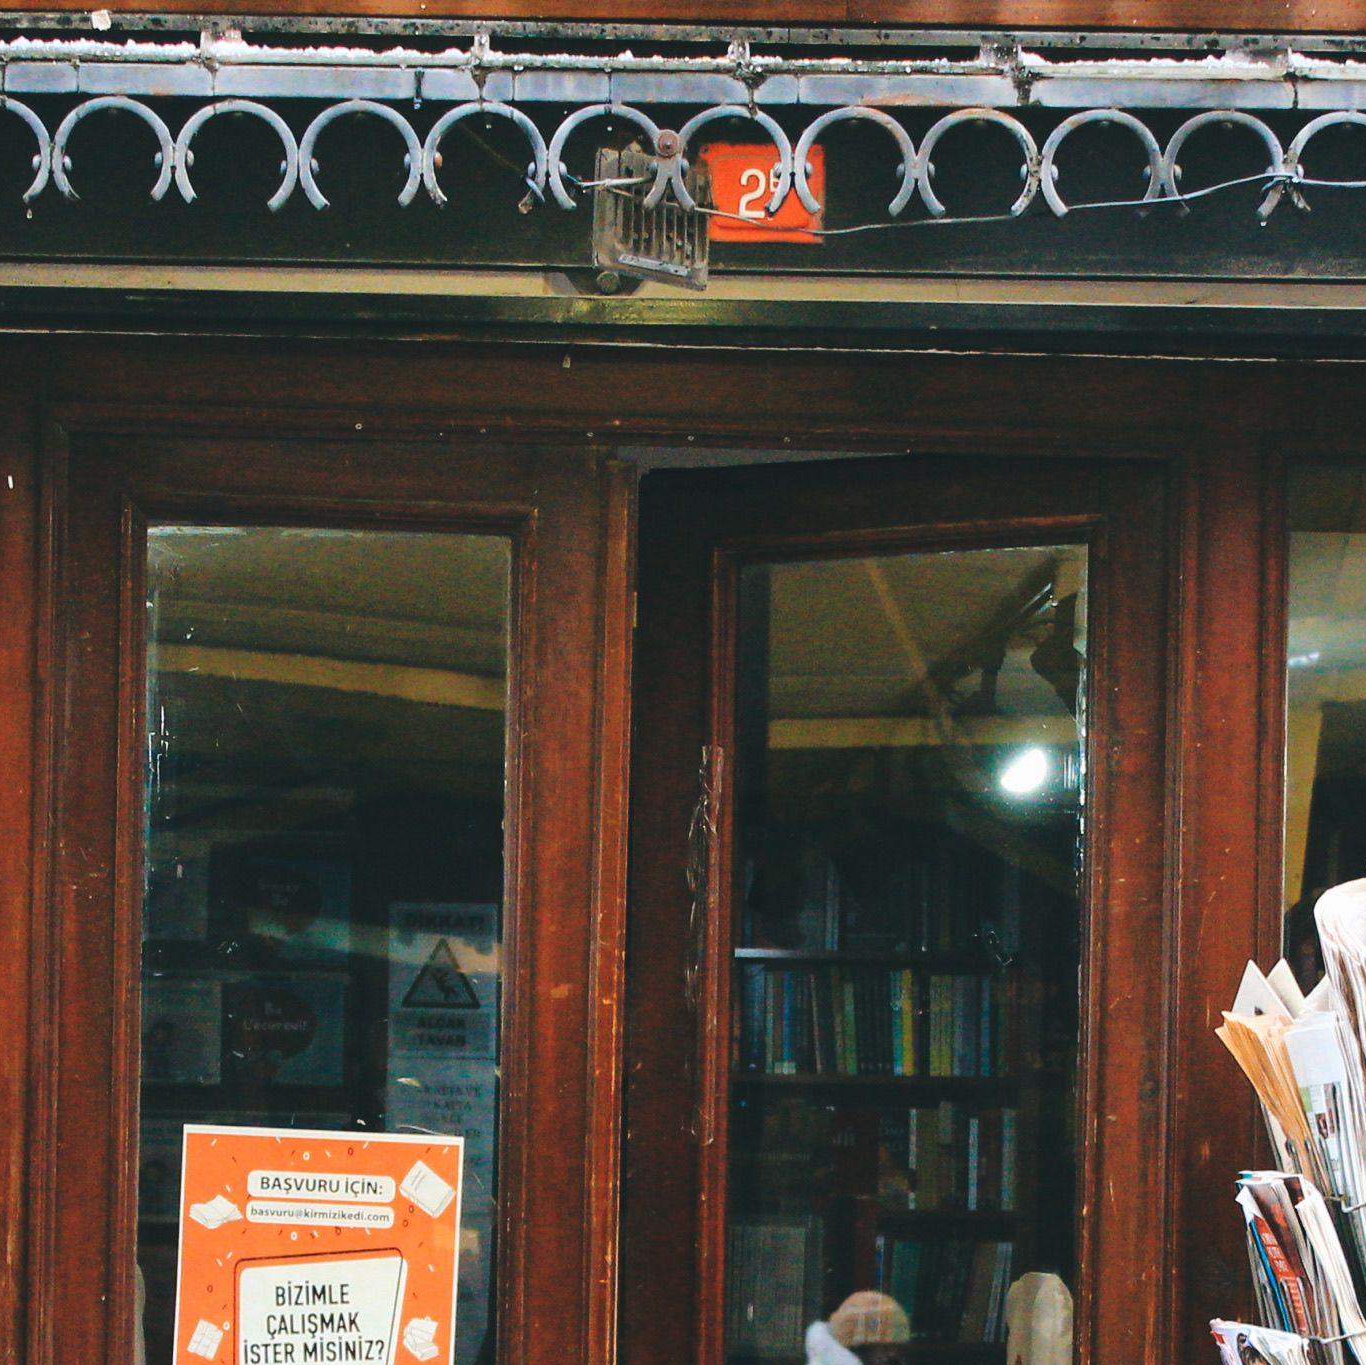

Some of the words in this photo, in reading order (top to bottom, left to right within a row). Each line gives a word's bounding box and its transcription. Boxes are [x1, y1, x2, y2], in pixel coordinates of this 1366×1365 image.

[260, 1176, 340, 1195] BAŞVURU
[344, 1180, 384, 1198] İÇİN:
[250, 1206, 390, 1223] basvuru@kirmizikedi.com
[275, 1279, 350, 1307] BİZİMLE
[266, 1312, 361, 1338] ÇALIŞMAK
[243, 1341, 295, 1365] İSTER
[303, 1338, 385, 1363] MİSİNİZ?
